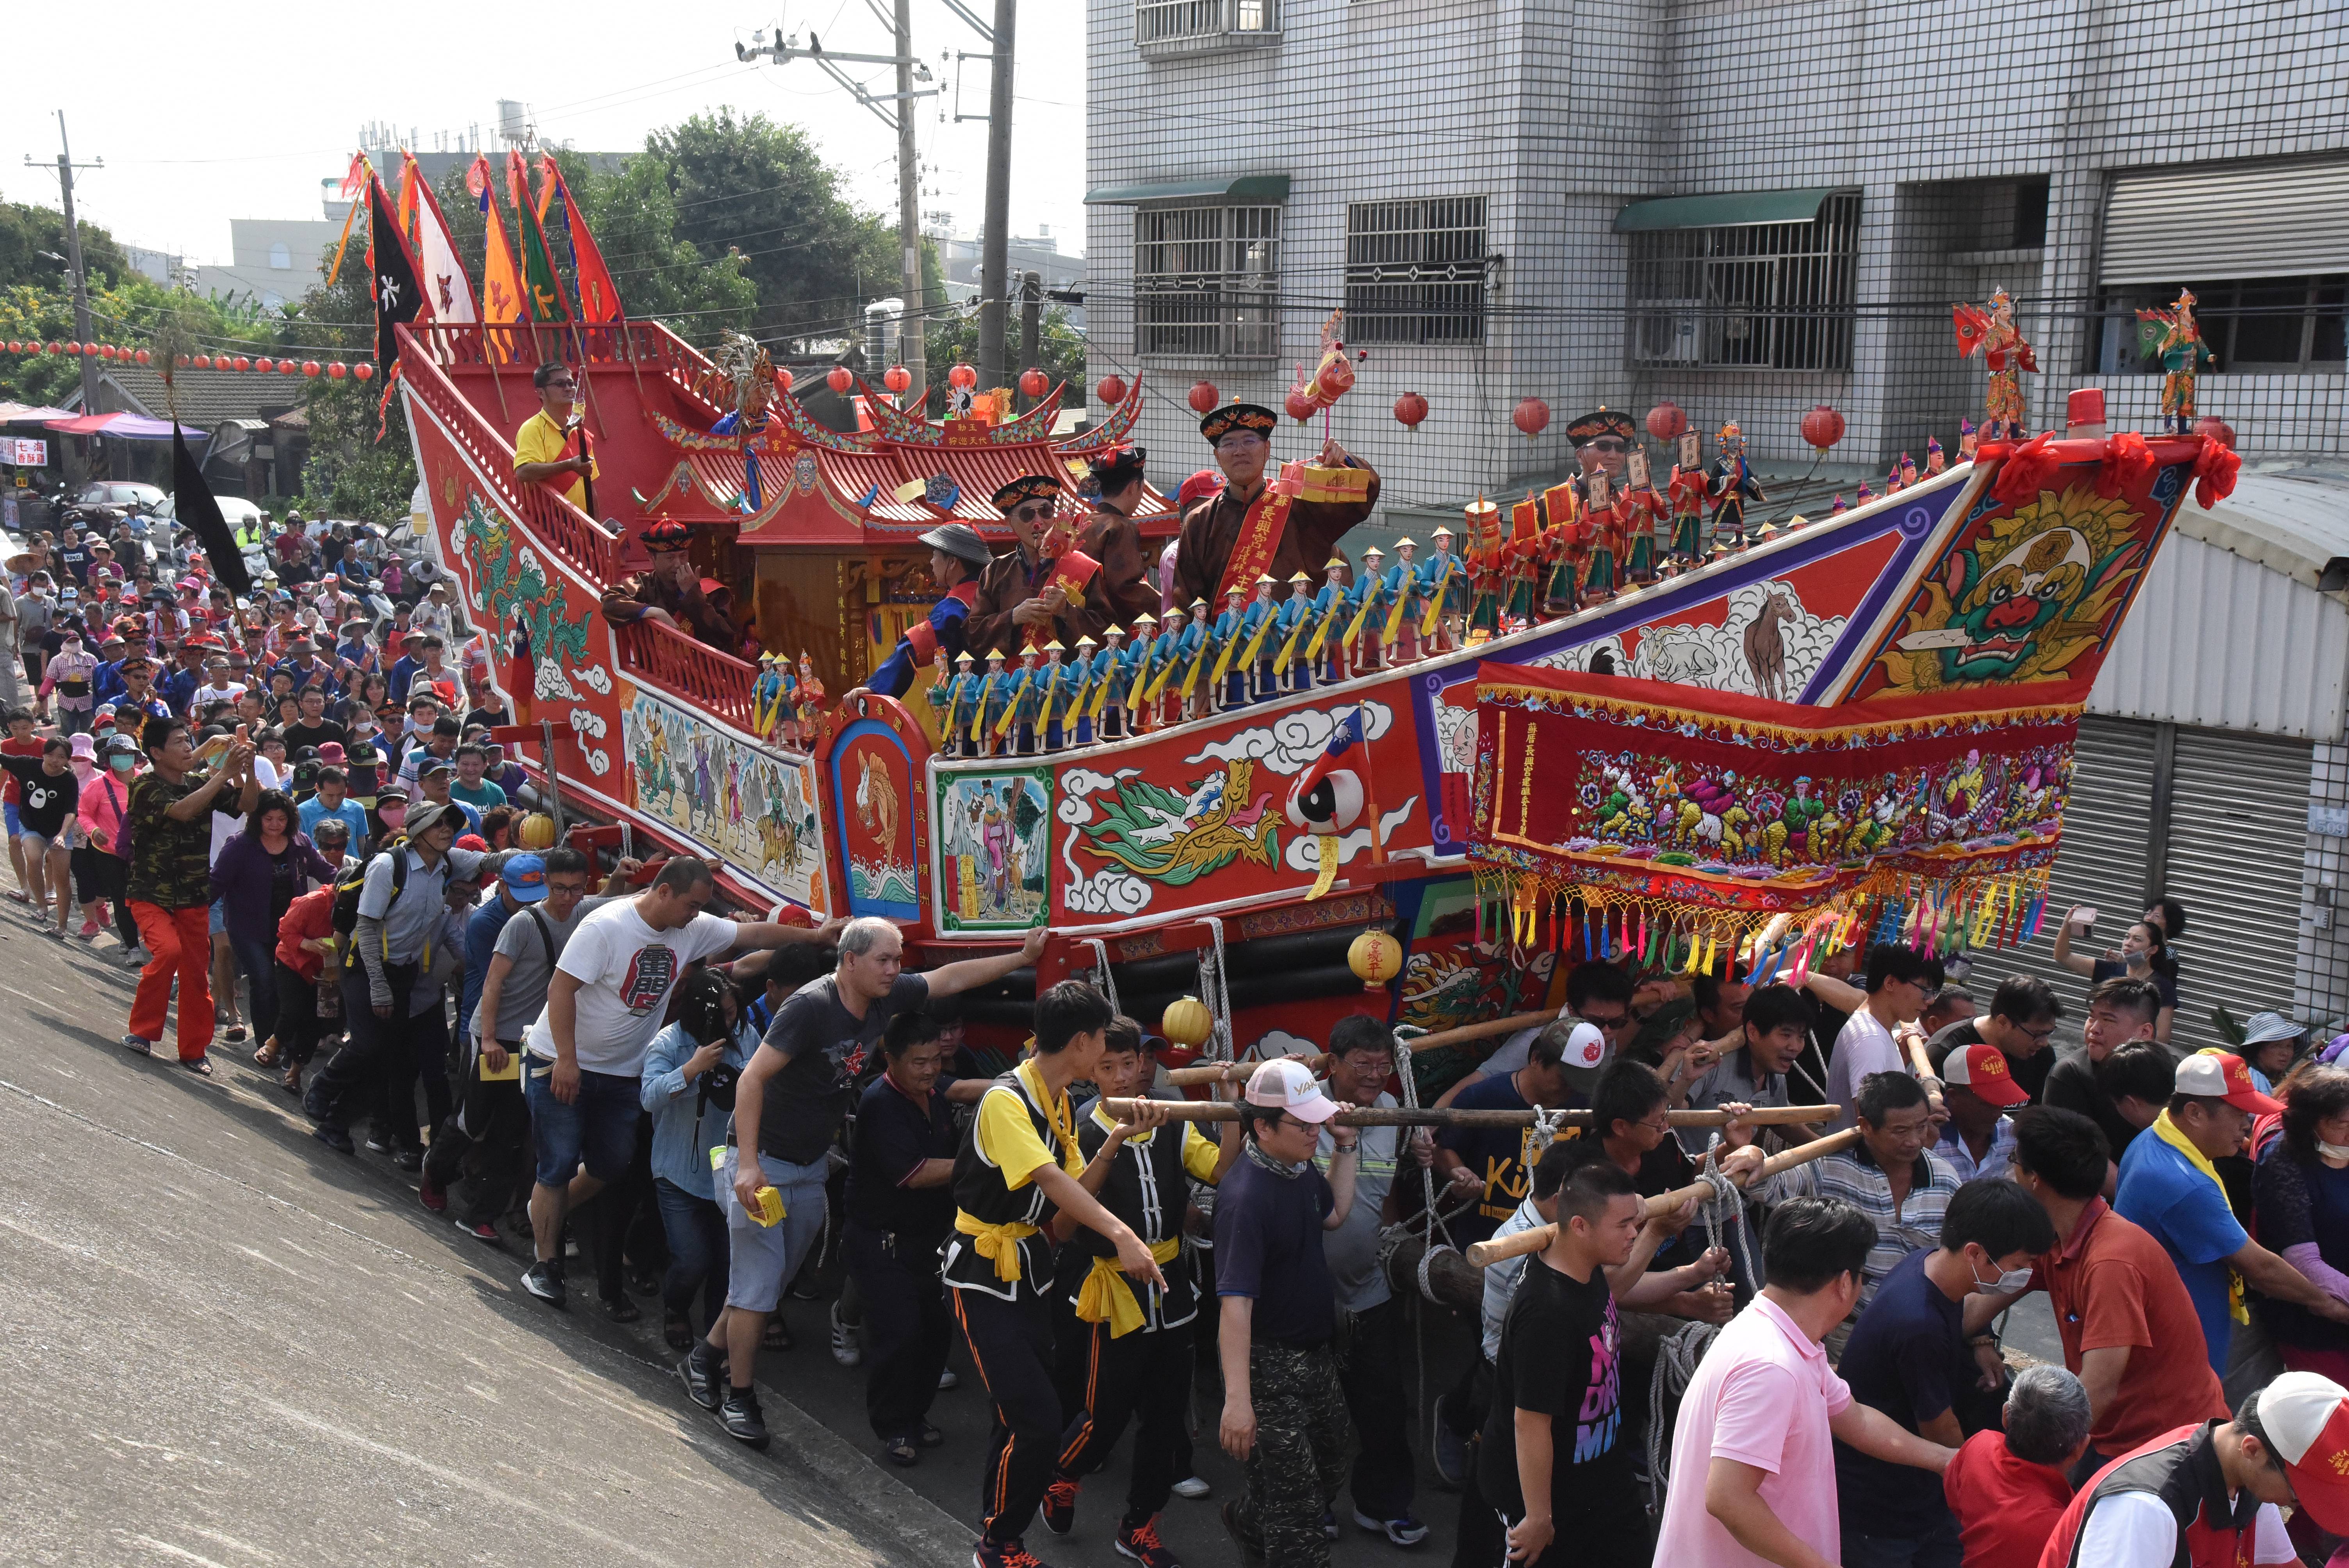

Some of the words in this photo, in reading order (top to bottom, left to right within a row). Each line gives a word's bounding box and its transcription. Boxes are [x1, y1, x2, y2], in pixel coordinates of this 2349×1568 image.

[17, 441, 44, 452] 七海
[949, 437, 987, 445] 代天巡狩
[1685, 438, 1694, 465] 肅靜
[18, 453, 45, 464] 香酥雞
[1251, 506, 1276, 549] 長興宮
[1232, 545, 1251, 574] 戊戌科
[837, 561, 843, 588] 弟子
[1518, 722, 1538, 838] 蘇厝長興宮建醮委員會製
